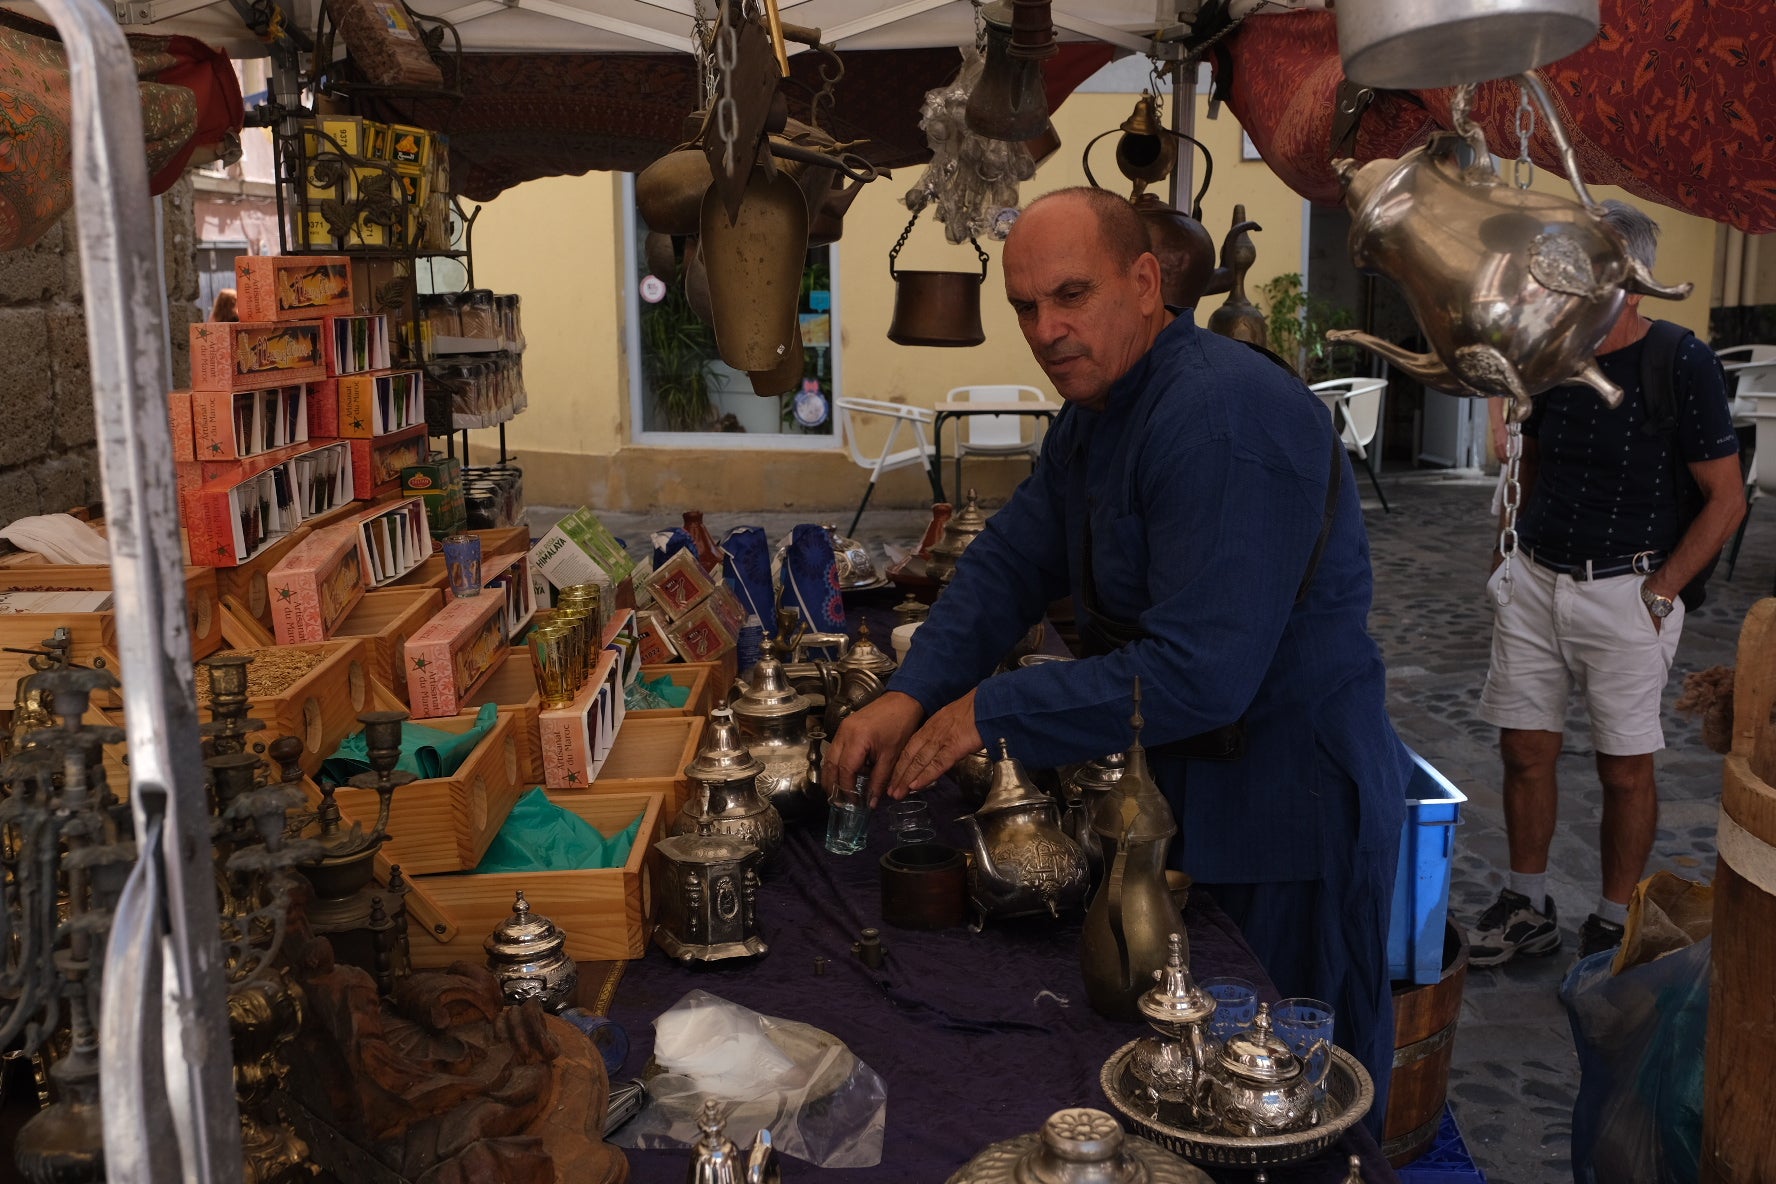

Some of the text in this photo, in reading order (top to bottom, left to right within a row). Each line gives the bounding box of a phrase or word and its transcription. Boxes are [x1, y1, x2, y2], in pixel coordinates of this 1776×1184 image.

[339, 129, 347, 148] 9371
[244, 283, 250, 293] du
[253, 278, 262, 314] Artisanat
[200, 404, 209, 441] Artisanat
[210, 425, 217, 436] du
[204, 502, 213, 543] Artisanat
[215, 526, 222, 538] du
[536, 538, 566, 568] HIMALAYA
[284, 607, 295, 645] du Maro
[294, 601, 306, 642] Artisanat
[419, 676, 427, 689] du
[429, 671, 440, 711] Artisanat
[554, 731, 564, 770] Artisanat
[567, 754, 574, 765] du
